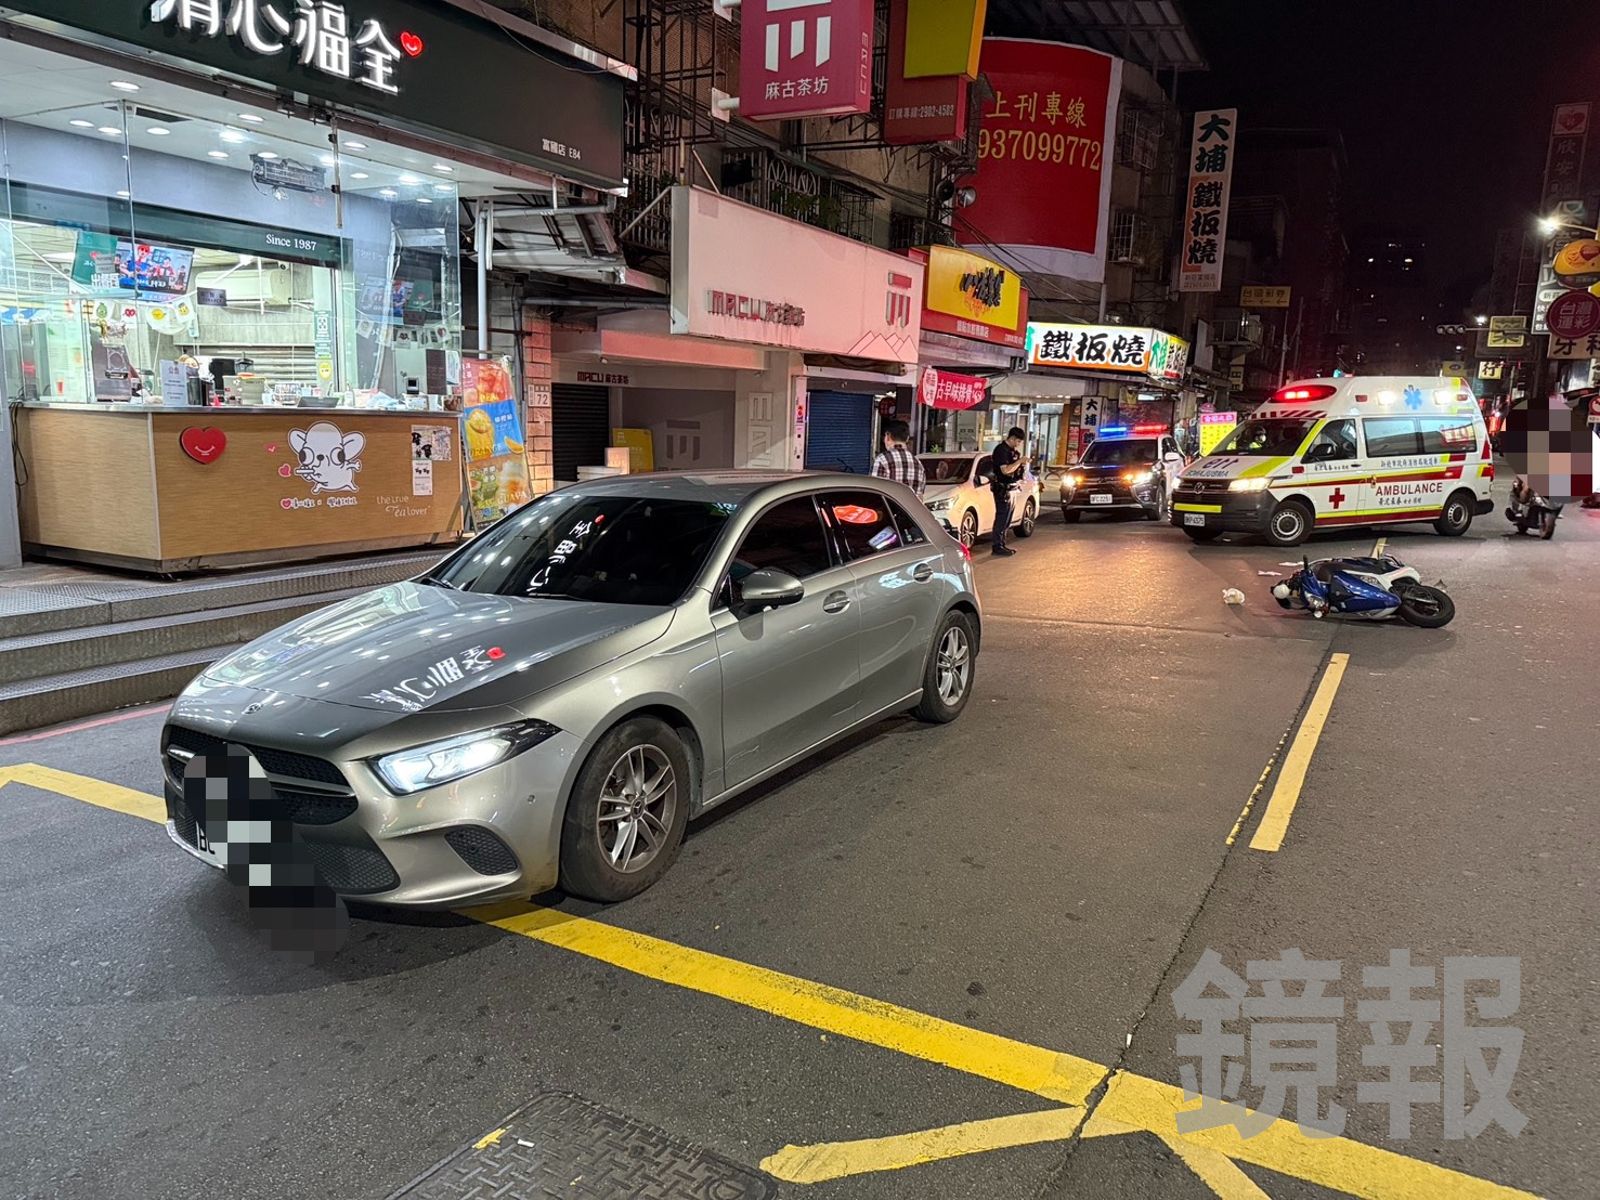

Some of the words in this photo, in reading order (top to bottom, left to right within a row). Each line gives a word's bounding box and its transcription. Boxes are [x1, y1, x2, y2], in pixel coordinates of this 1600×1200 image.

[765, 76, 830, 101] 麻古茶坊
[985, 90, 1088, 129] 上刊專線
[266, 233, 291, 247] Since
[294, 238, 317, 251] 1987
[1040, 330, 1146, 365] 鐵板燒
[577, 371, 604, 383] MACU
[537, 394, 548, 405] 72
[1375, 482, 1443, 496] AMBULANCE
